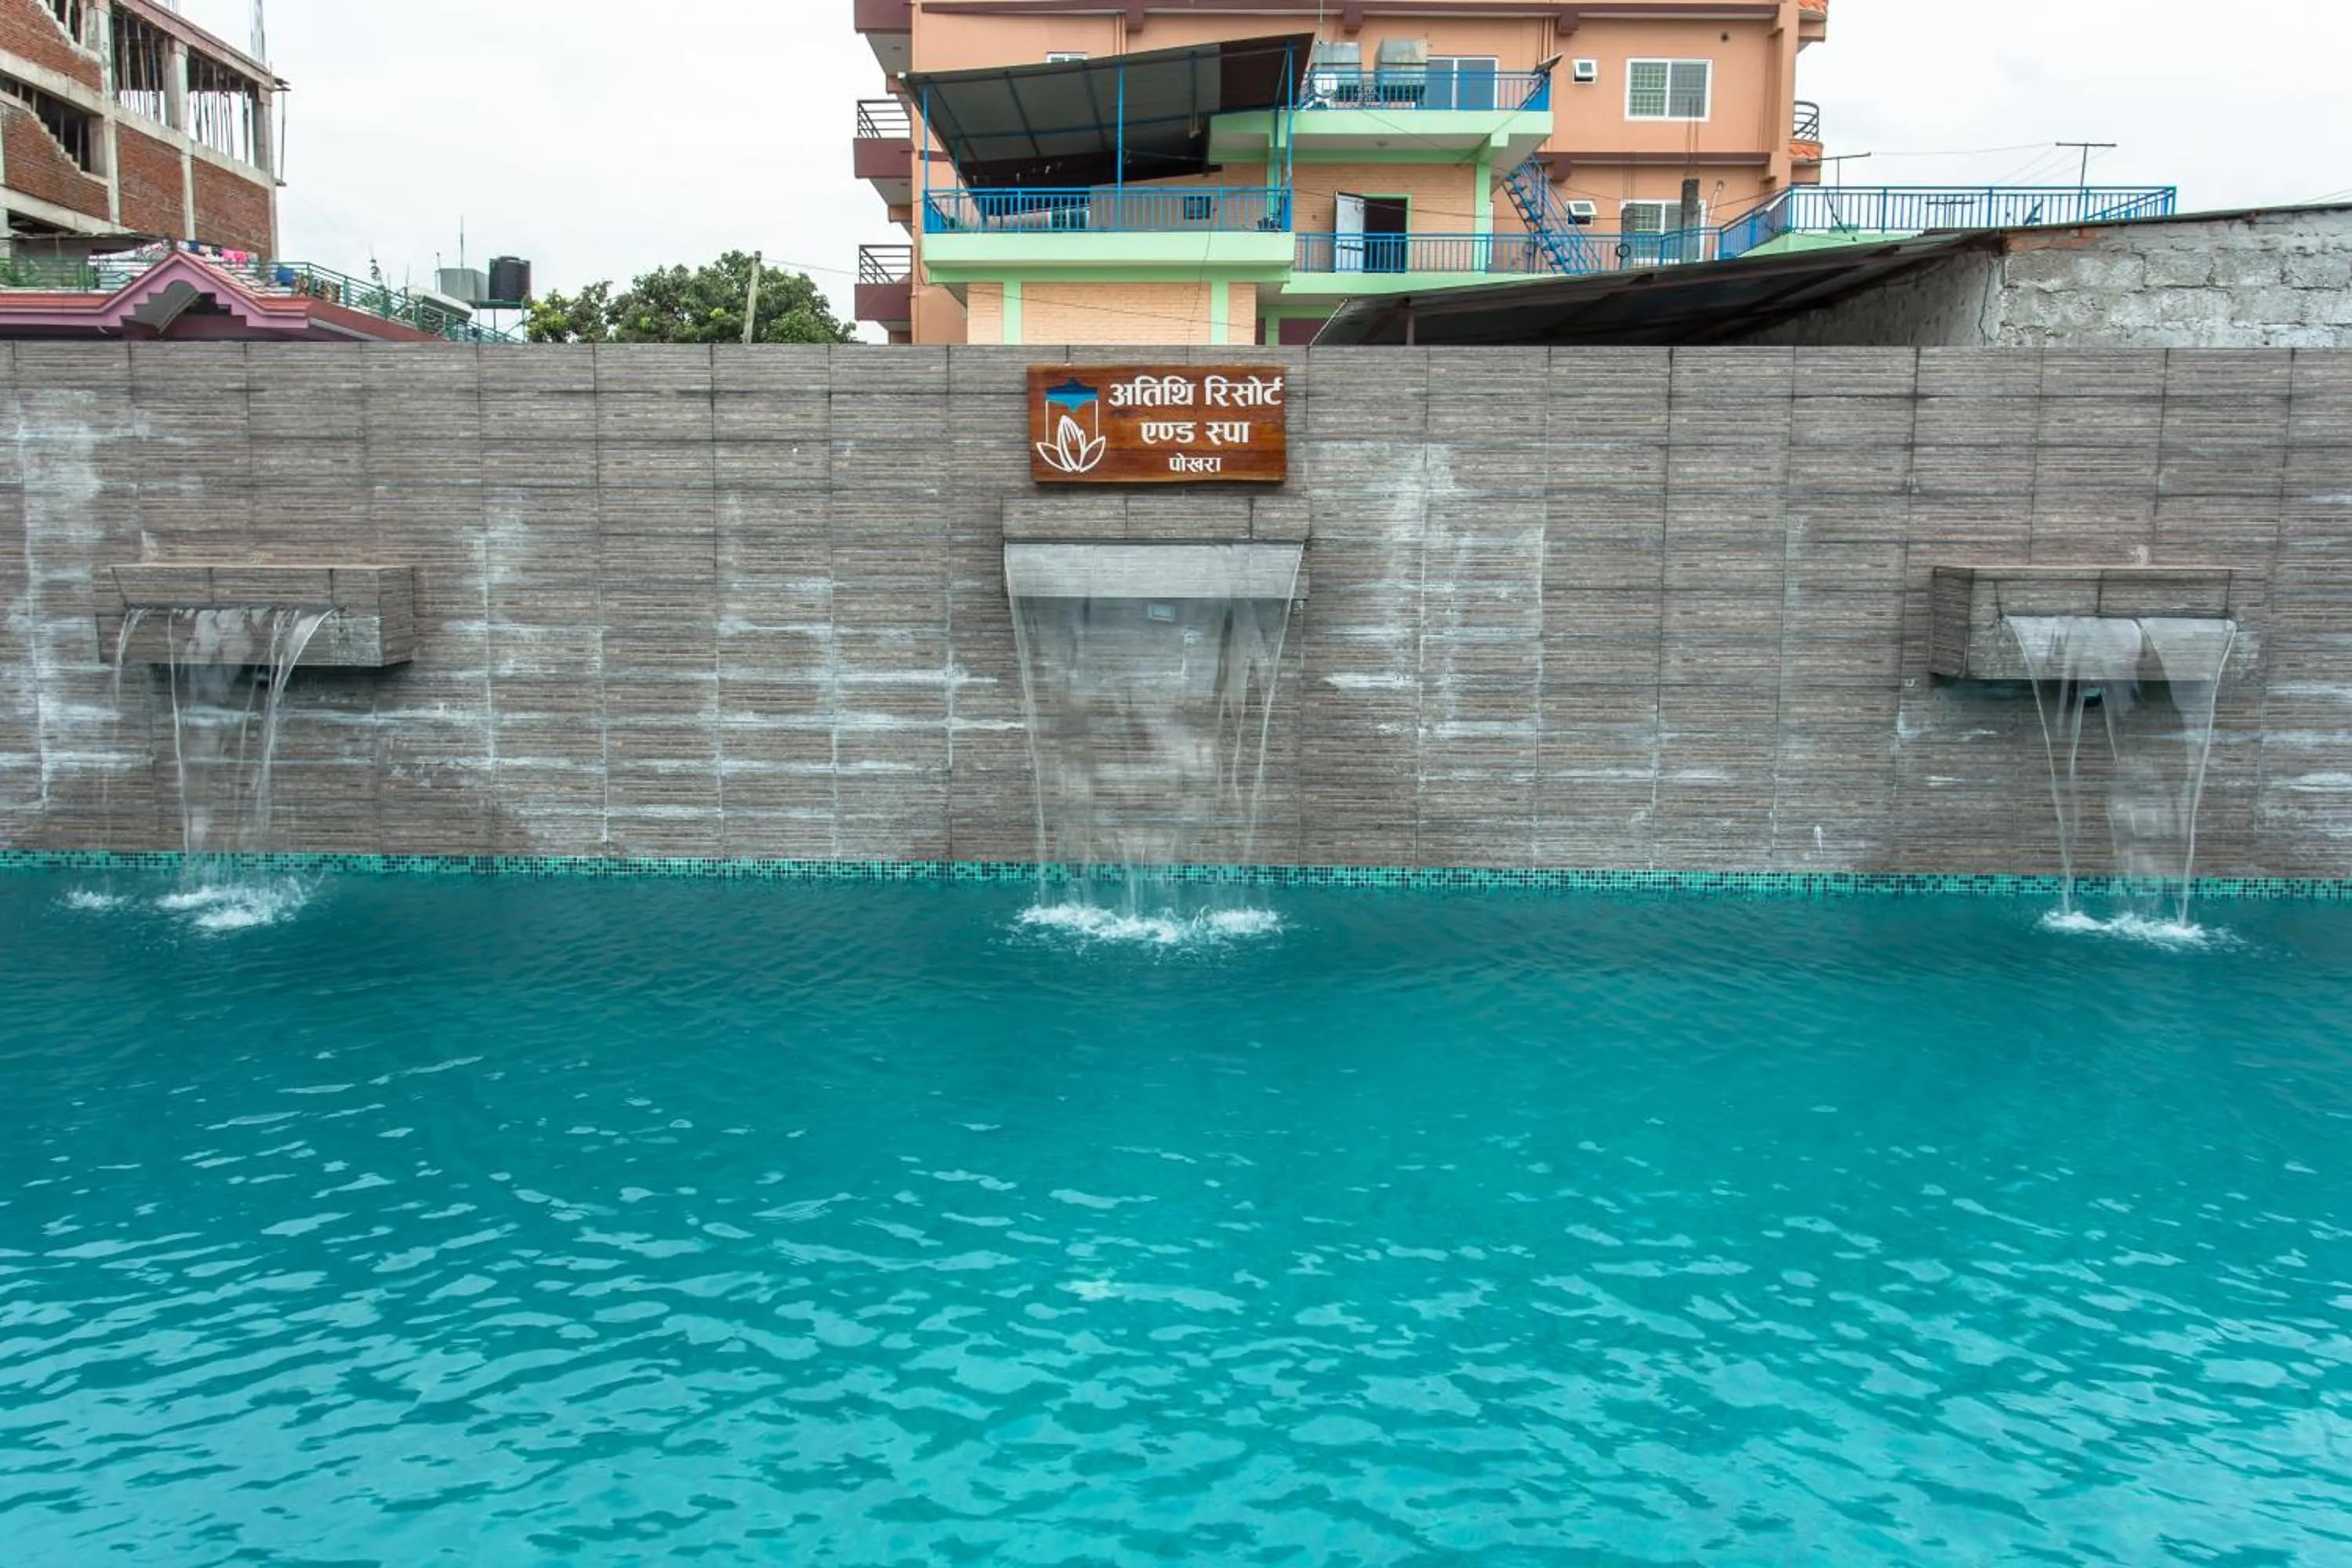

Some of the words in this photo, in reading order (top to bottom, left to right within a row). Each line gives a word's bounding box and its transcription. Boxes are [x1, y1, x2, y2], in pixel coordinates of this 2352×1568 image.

[1108, 375, 1196, 407] अतिथि
[1204, 375, 1284, 407] रिसोर्ट
[1140, 421, 1197, 444] एण्ड
[1205, 421, 1250, 446] स्पा
[1168, 452, 1221, 473] पोखरा
